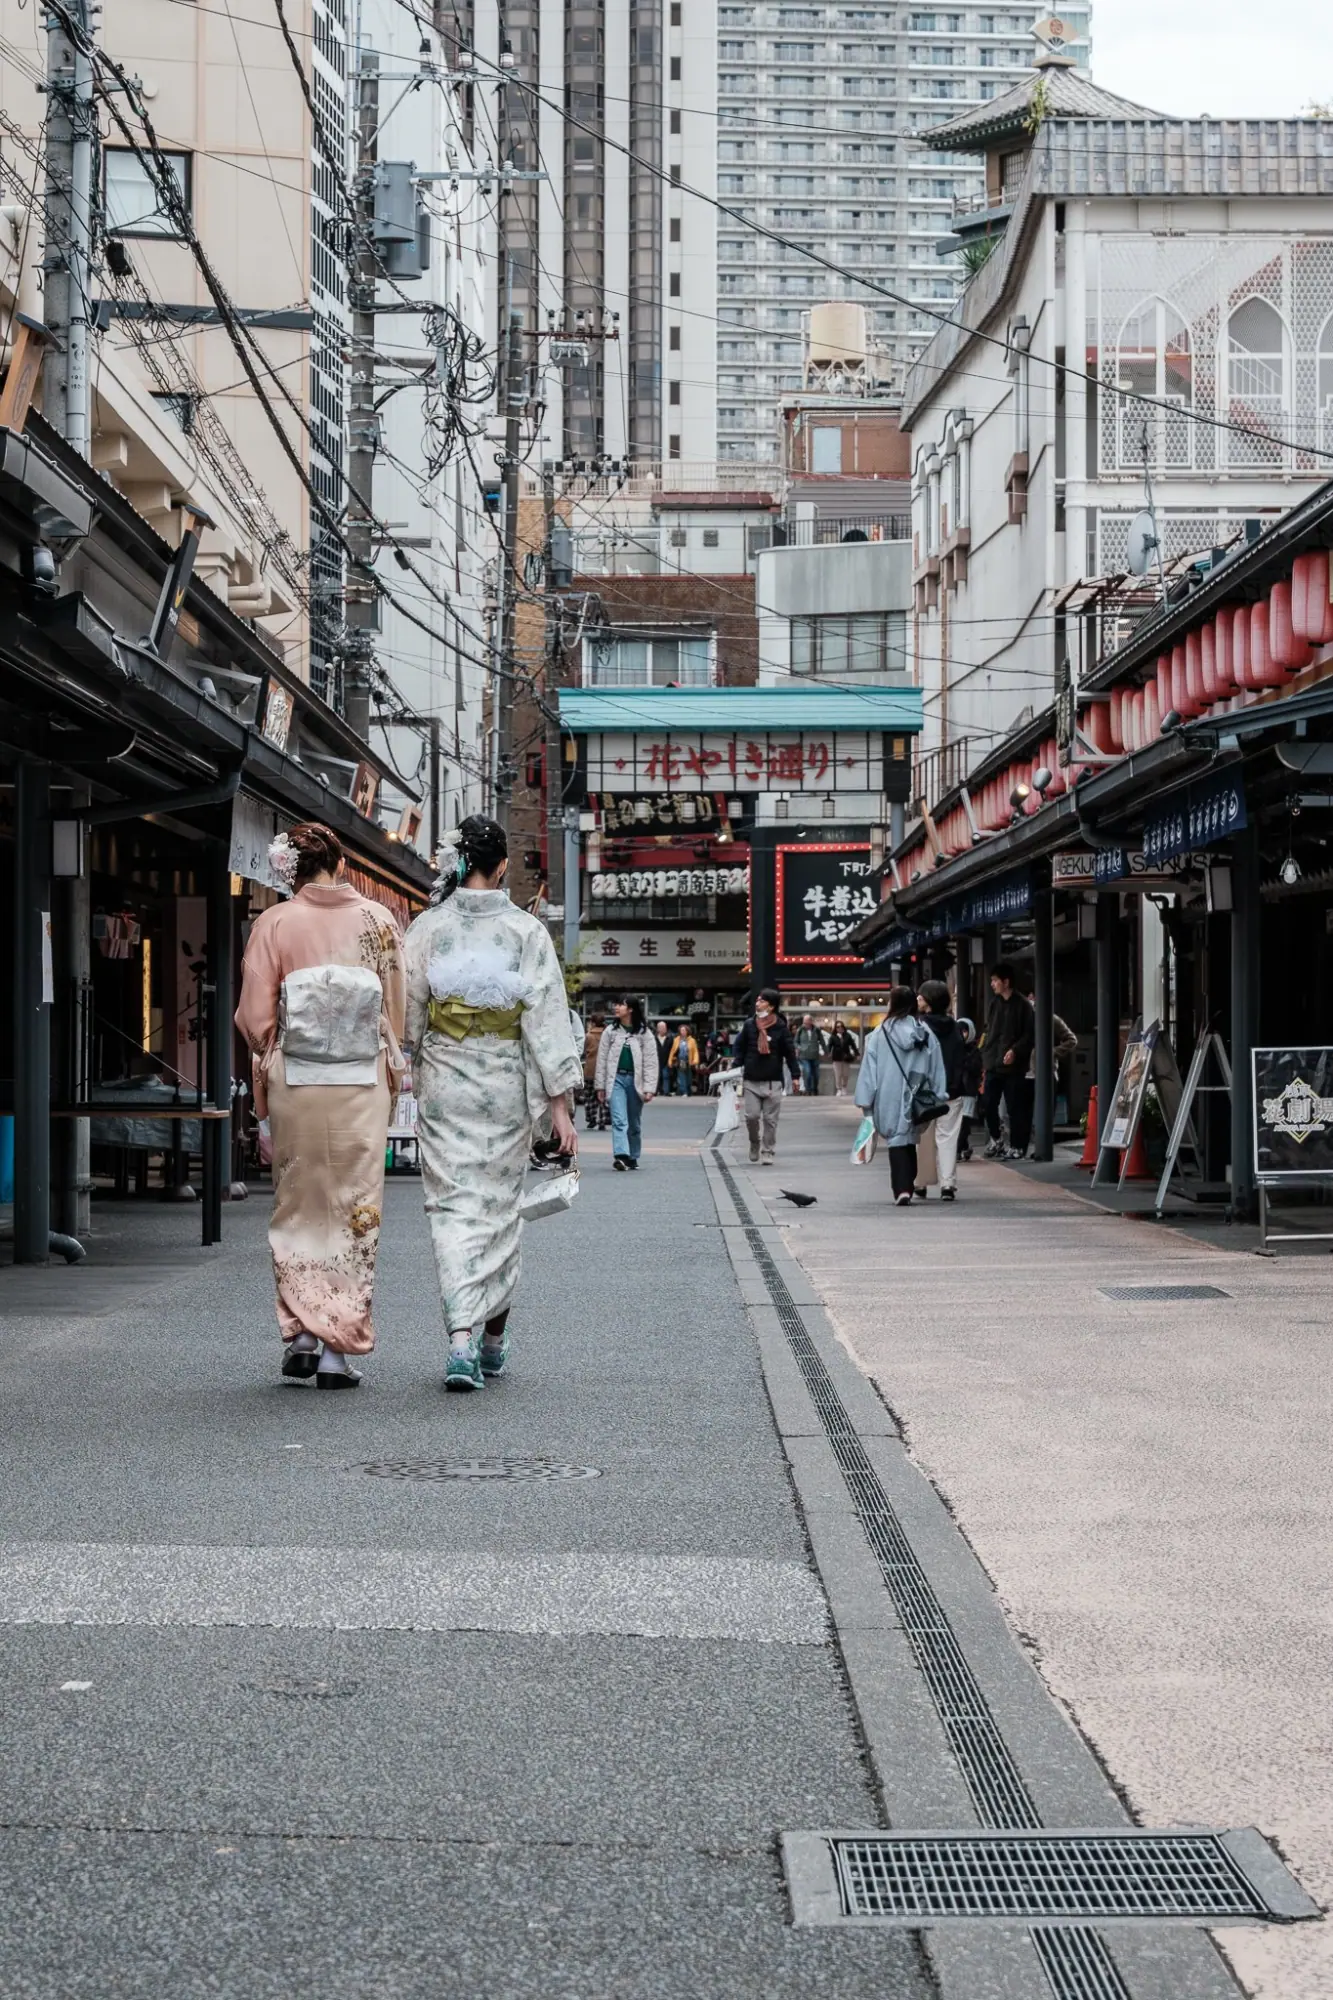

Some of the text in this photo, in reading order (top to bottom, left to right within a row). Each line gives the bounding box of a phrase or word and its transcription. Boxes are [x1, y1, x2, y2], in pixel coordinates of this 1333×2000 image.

[642, 741, 829, 782] 花やしき通り
[802, 885, 878, 918] 牛煮込
[804, 917, 866, 942] レモン
[601, 936, 696, 958] 金生堂
